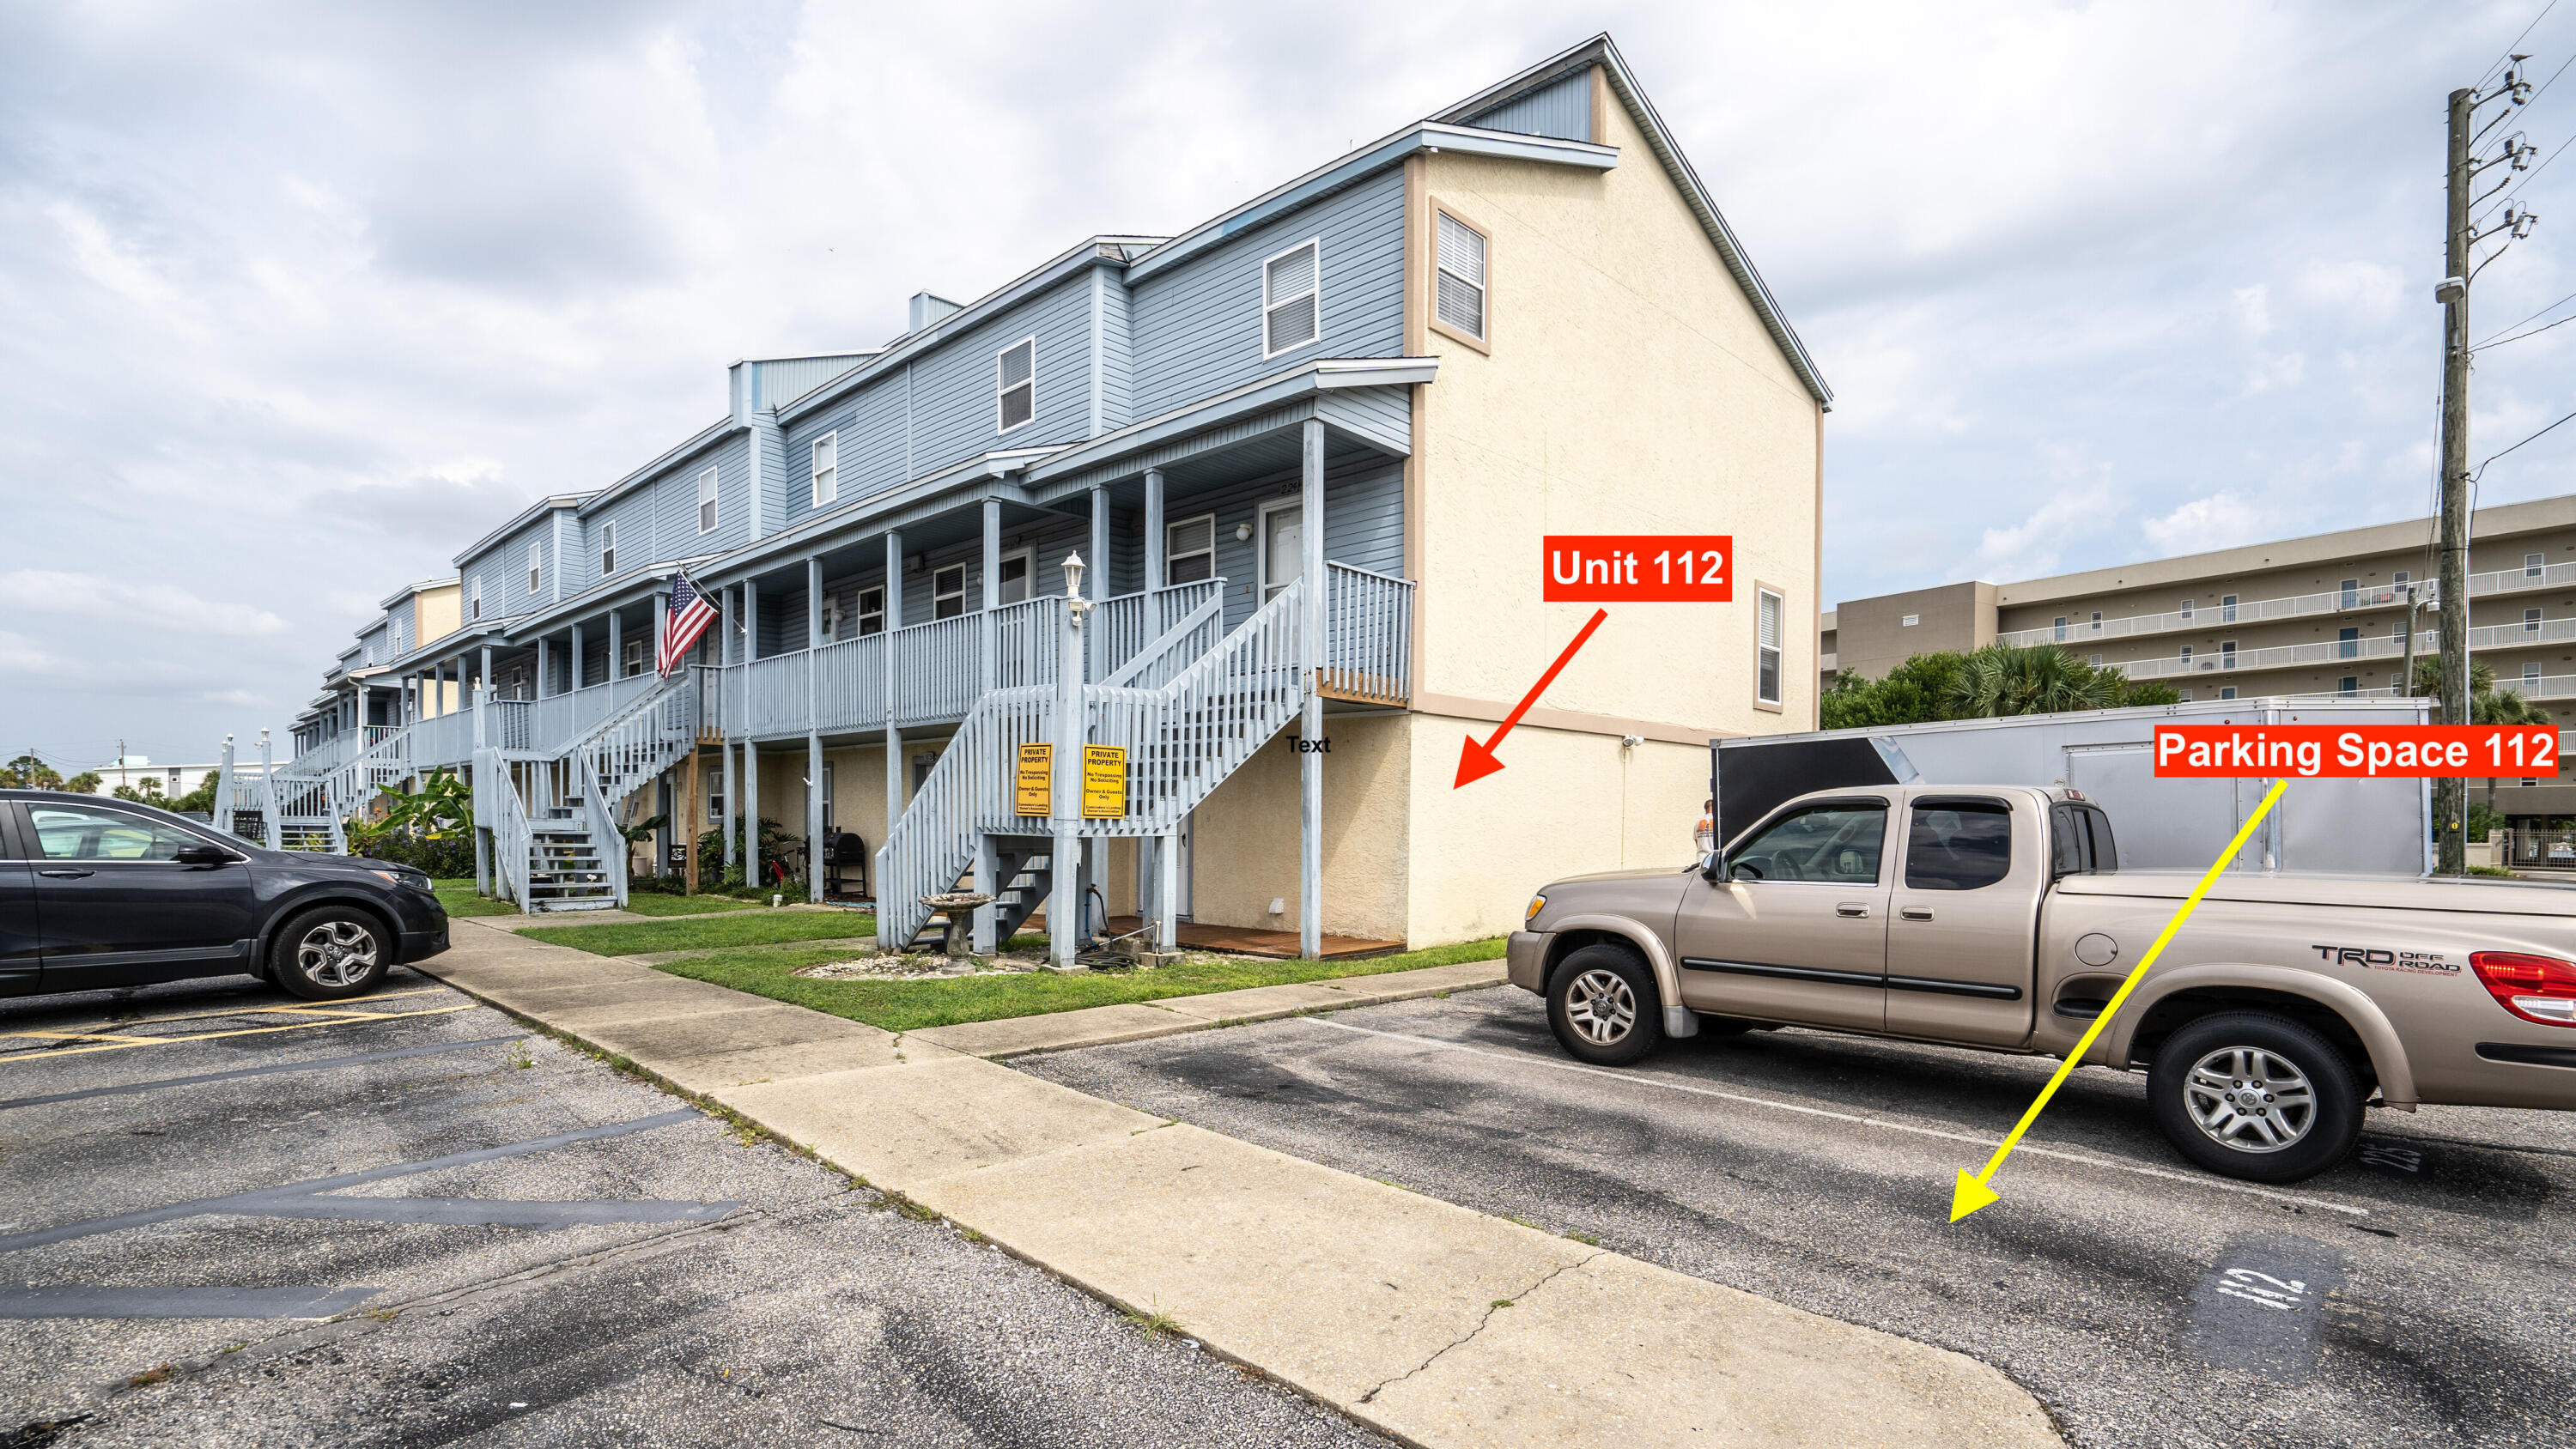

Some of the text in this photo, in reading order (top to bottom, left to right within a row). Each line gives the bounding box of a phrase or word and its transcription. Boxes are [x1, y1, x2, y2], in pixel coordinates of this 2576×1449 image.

[1087, 758, 1121, 767] PROPERTY
[2312, 945, 2396, 967] TRD
[2399, 951, 2445, 961] OFF
[2398, 960, 2462, 973] ROAD
[2417, 968, 2458, 977] DEVELOPMENT
[2215, 1269, 2306, 1311] 112
